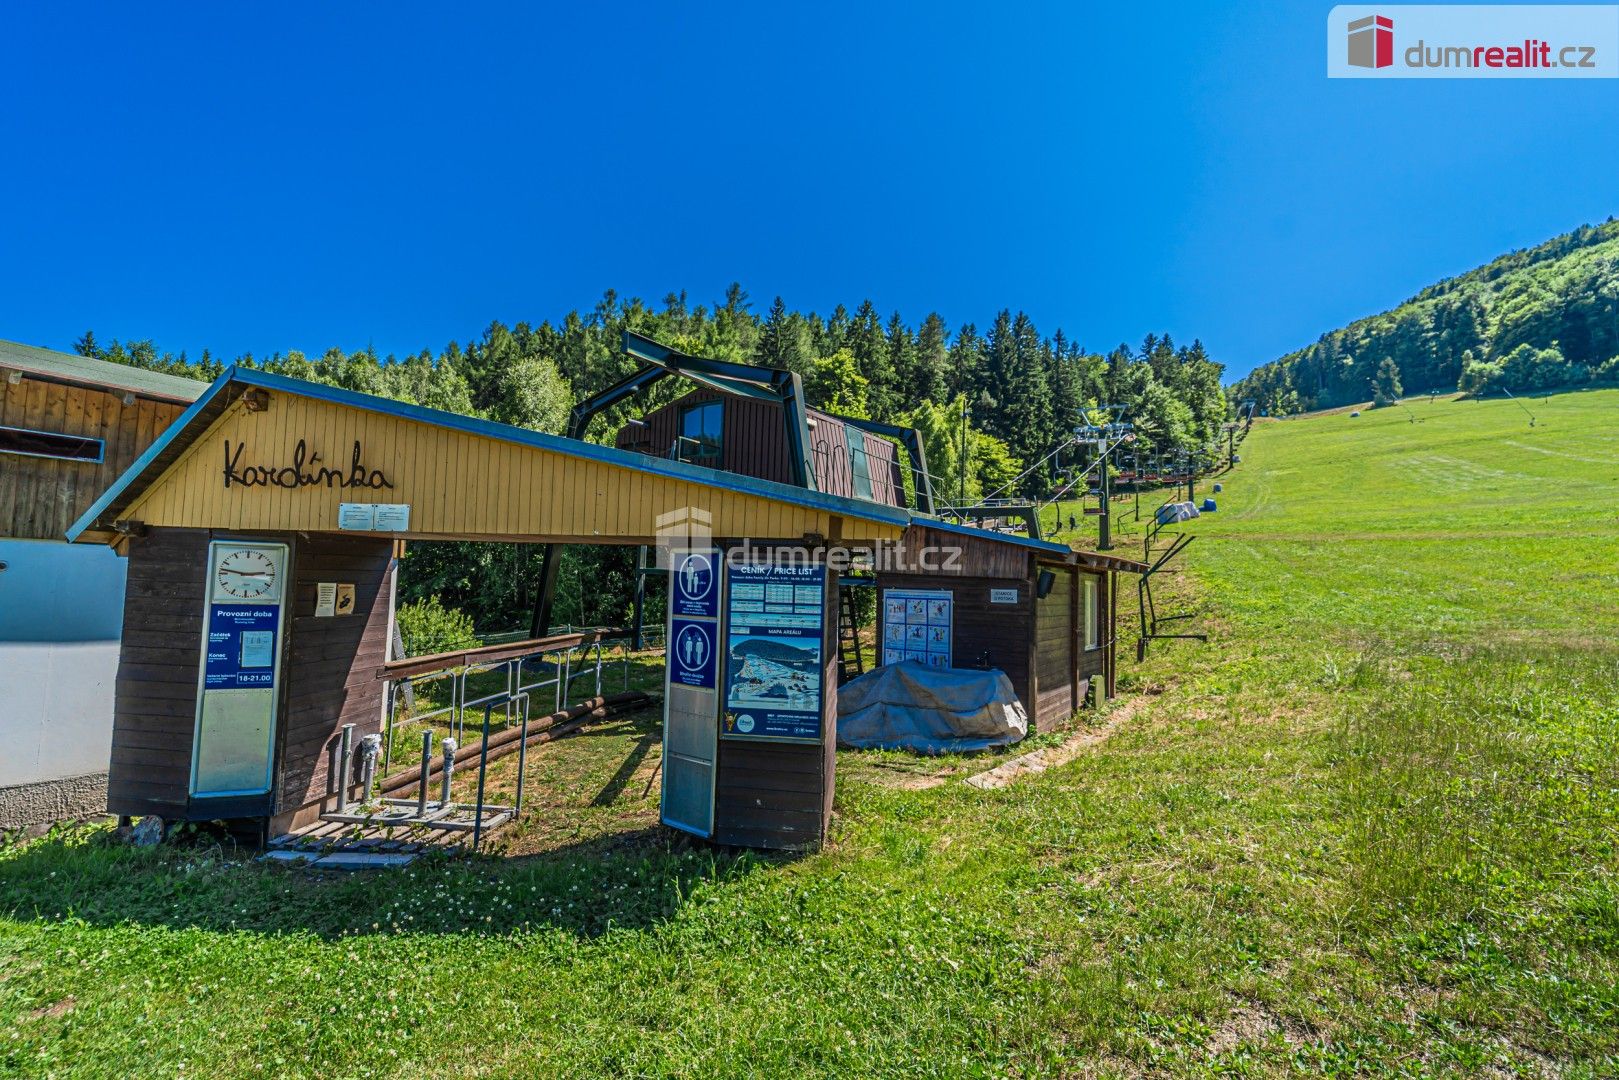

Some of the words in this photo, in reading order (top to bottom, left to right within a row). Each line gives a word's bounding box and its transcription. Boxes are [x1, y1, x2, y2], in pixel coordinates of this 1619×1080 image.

[741, 565, 765, 574] CENÍK
[774, 567, 797, 575] PRICE
[798, 568, 813, 576] LIST
